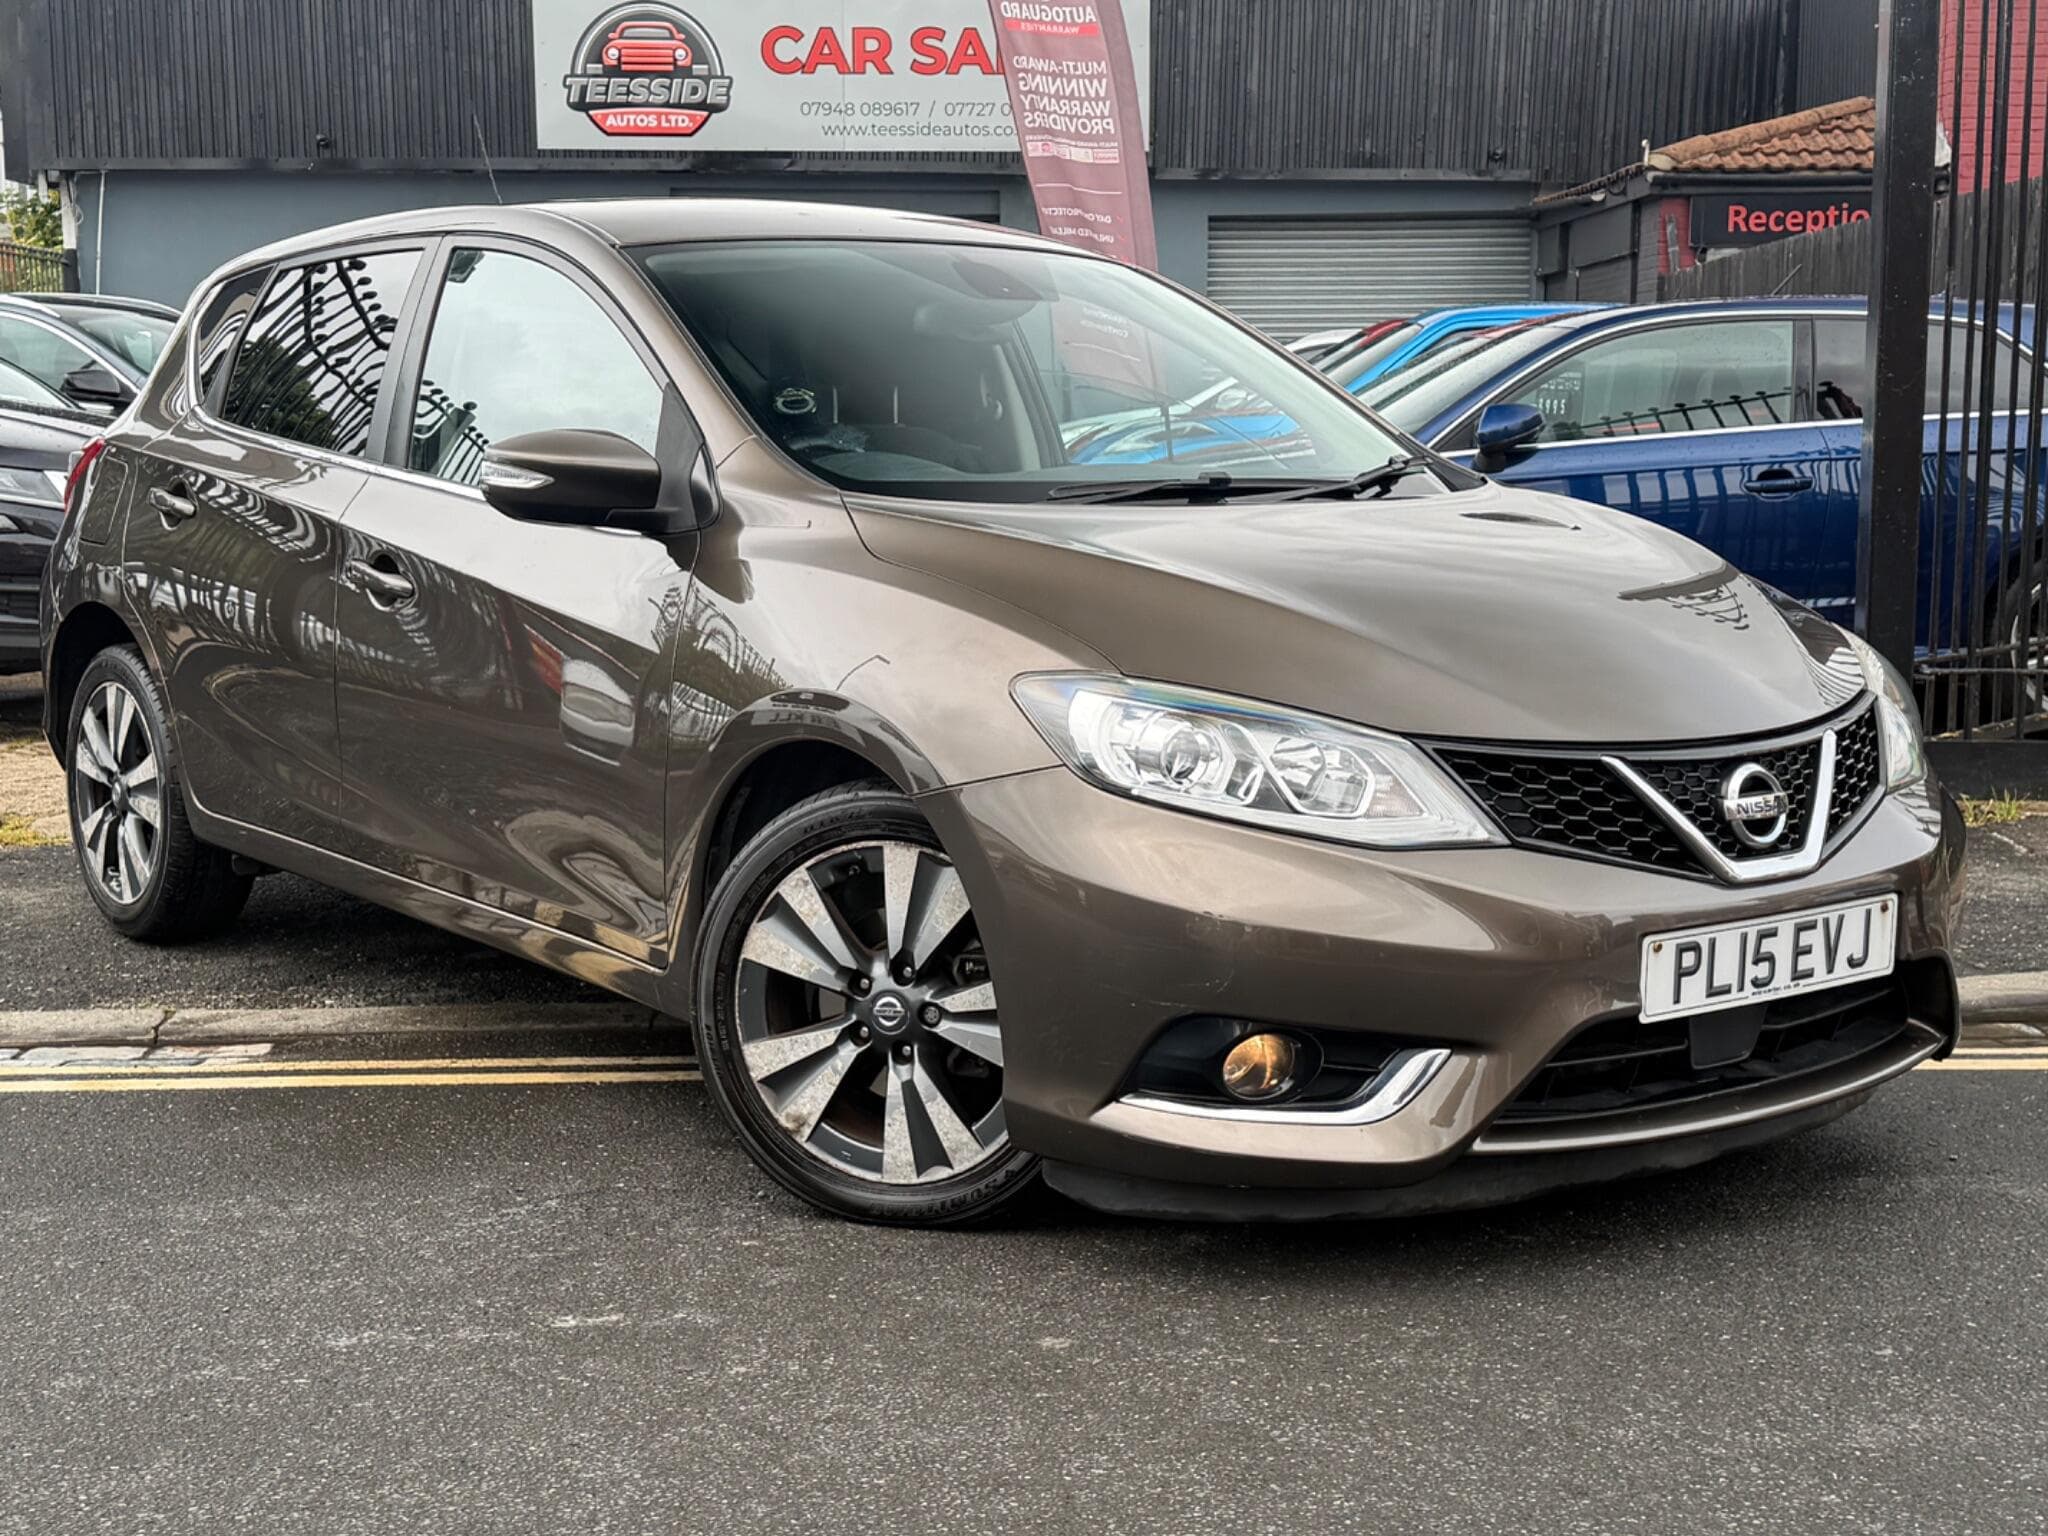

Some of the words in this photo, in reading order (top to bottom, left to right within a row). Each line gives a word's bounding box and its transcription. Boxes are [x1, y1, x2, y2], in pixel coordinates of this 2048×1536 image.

[761, 25, 894, 75] CAR
[909, 26, 1006, 75] SA
[565, 77, 731, 104] TEESSIDE
[605, 115, 658, 127] AUTOS
[661, 115, 693, 127] LTD.
[800, 101, 855, 117] 07948
[860, 101, 920, 117] 089617
[944, 101, 995, 117] 07727
[1673, 926, 1778, 1005] PL15
[1791, 908, 1872, 981] EVJ
